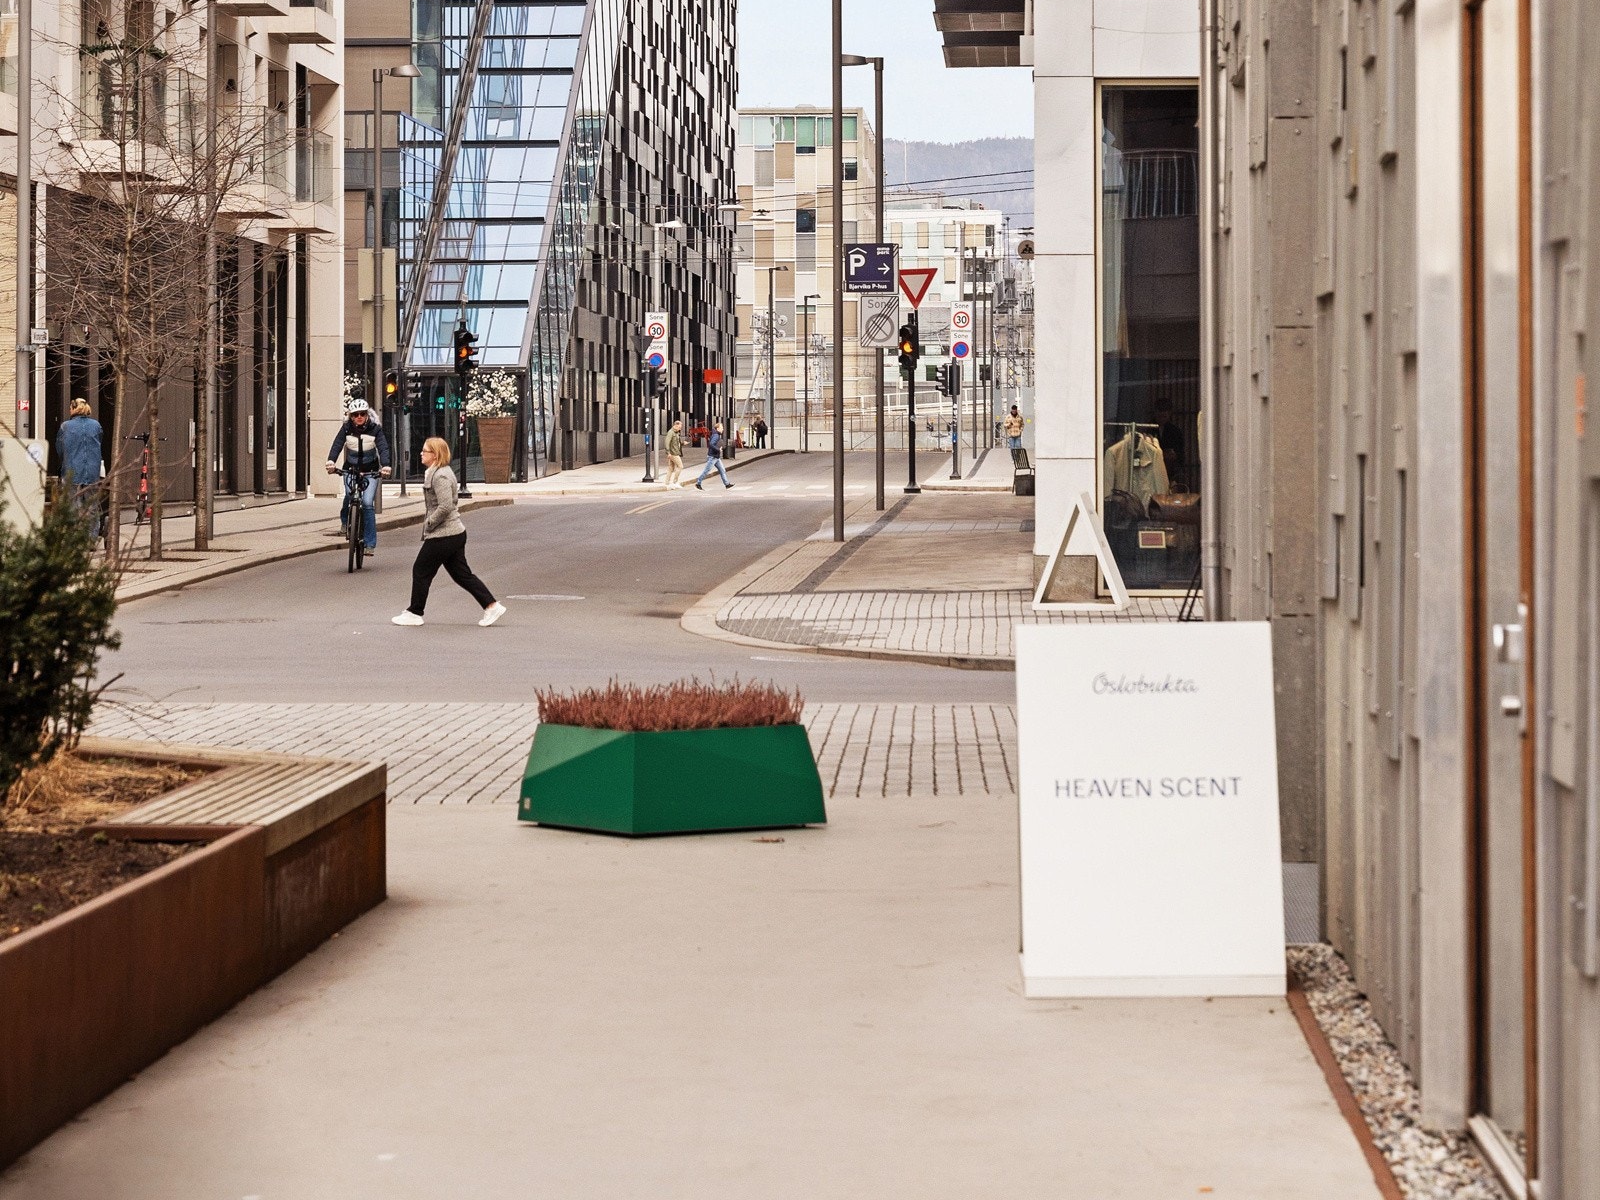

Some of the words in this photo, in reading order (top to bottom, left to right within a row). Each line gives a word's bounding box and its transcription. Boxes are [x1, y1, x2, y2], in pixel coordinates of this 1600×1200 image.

[850, 254, 866, 276] P
[652, 326, 662, 336] 30
[956, 316, 966, 324] 30
[1092, 672, 1199, 694] Oslobukta
[1055, 778, 1152, 798] HEAVEN
[1160, 776, 1242, 798] SCENT
